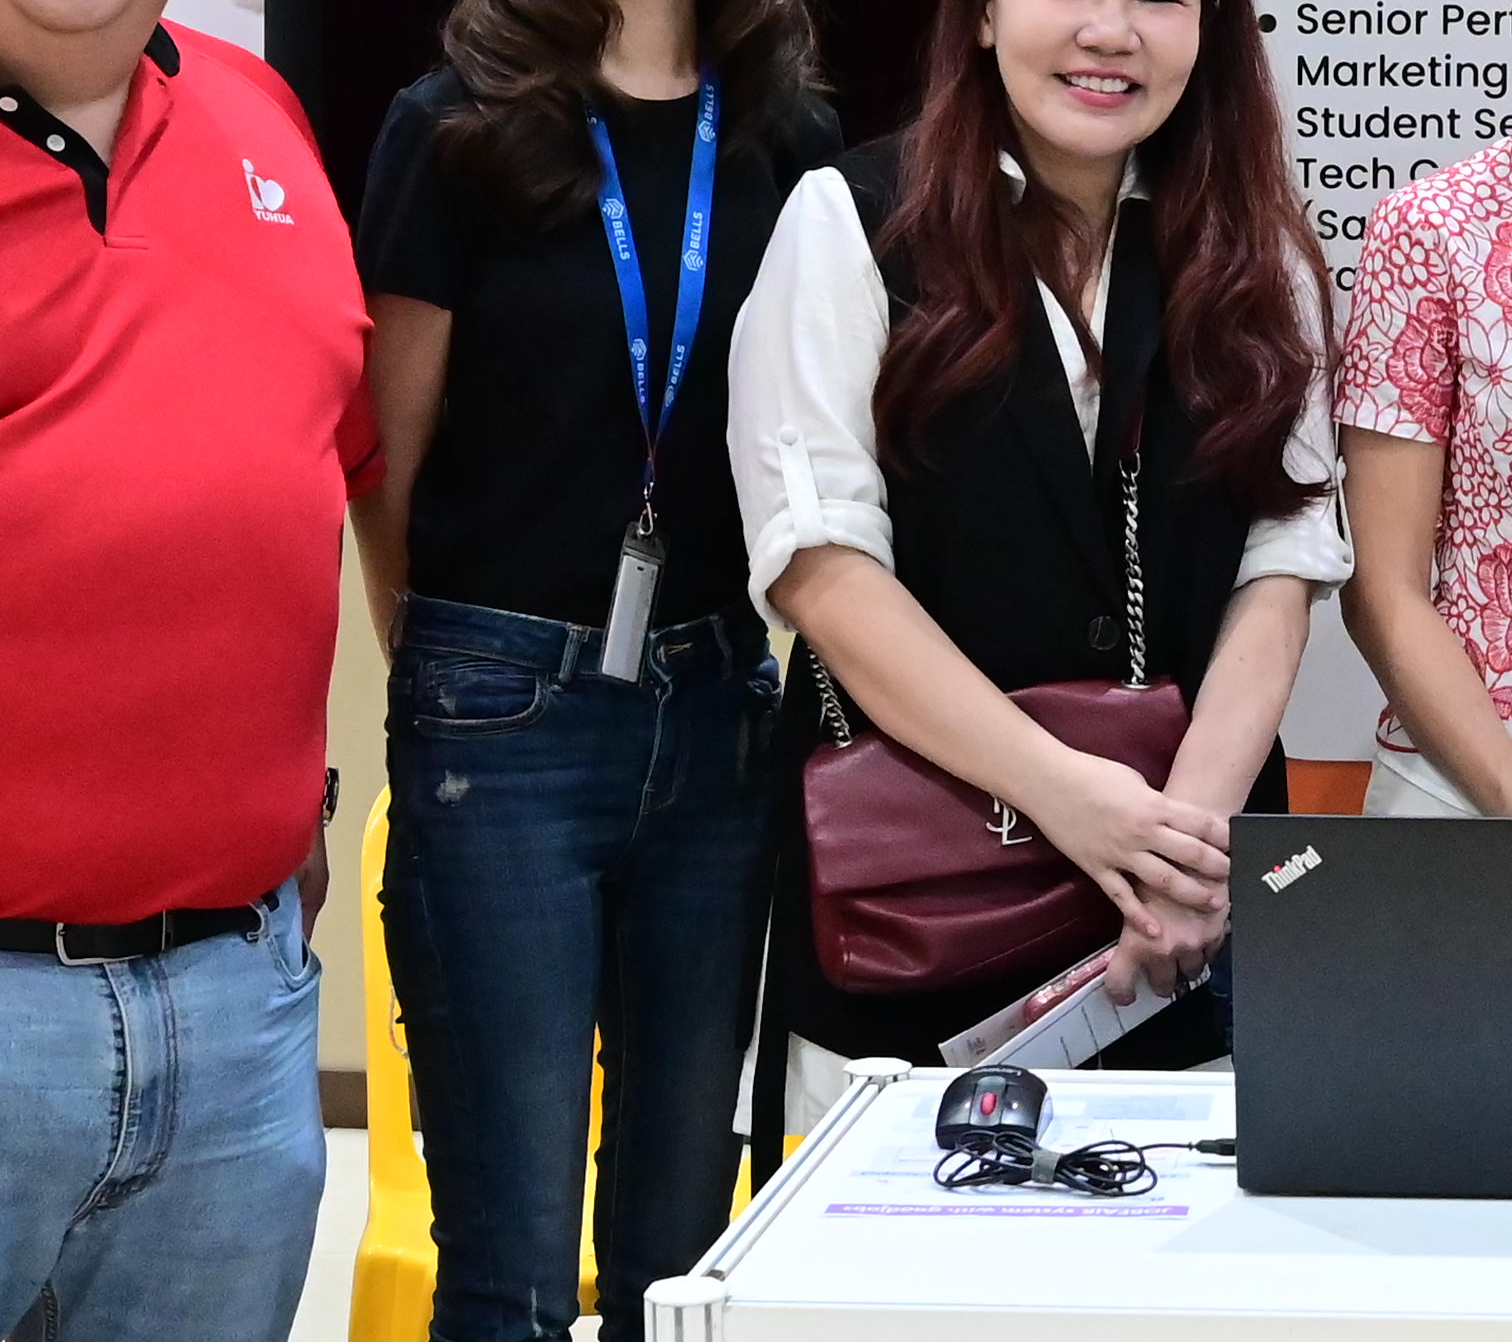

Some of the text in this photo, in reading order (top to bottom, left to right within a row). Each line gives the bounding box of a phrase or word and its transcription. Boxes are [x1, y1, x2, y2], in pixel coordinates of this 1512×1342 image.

[1297, 1, 1428, 35] Senior
[1297, 54, 1508, 99] Marketing
[703, 83, 715, 124] BELLS
[1297, 106, 1461, 139] Student
[1297, 157, 1394, 189] Tech
[254, 209, 295, 225] YUHUA
[689, 210, 704, 251] BELLS
[612, 221, 630, 261] BELLS
[670, 343, 685, 386] BELLS
[1261, 845, 1324, 894] ThinkPad
